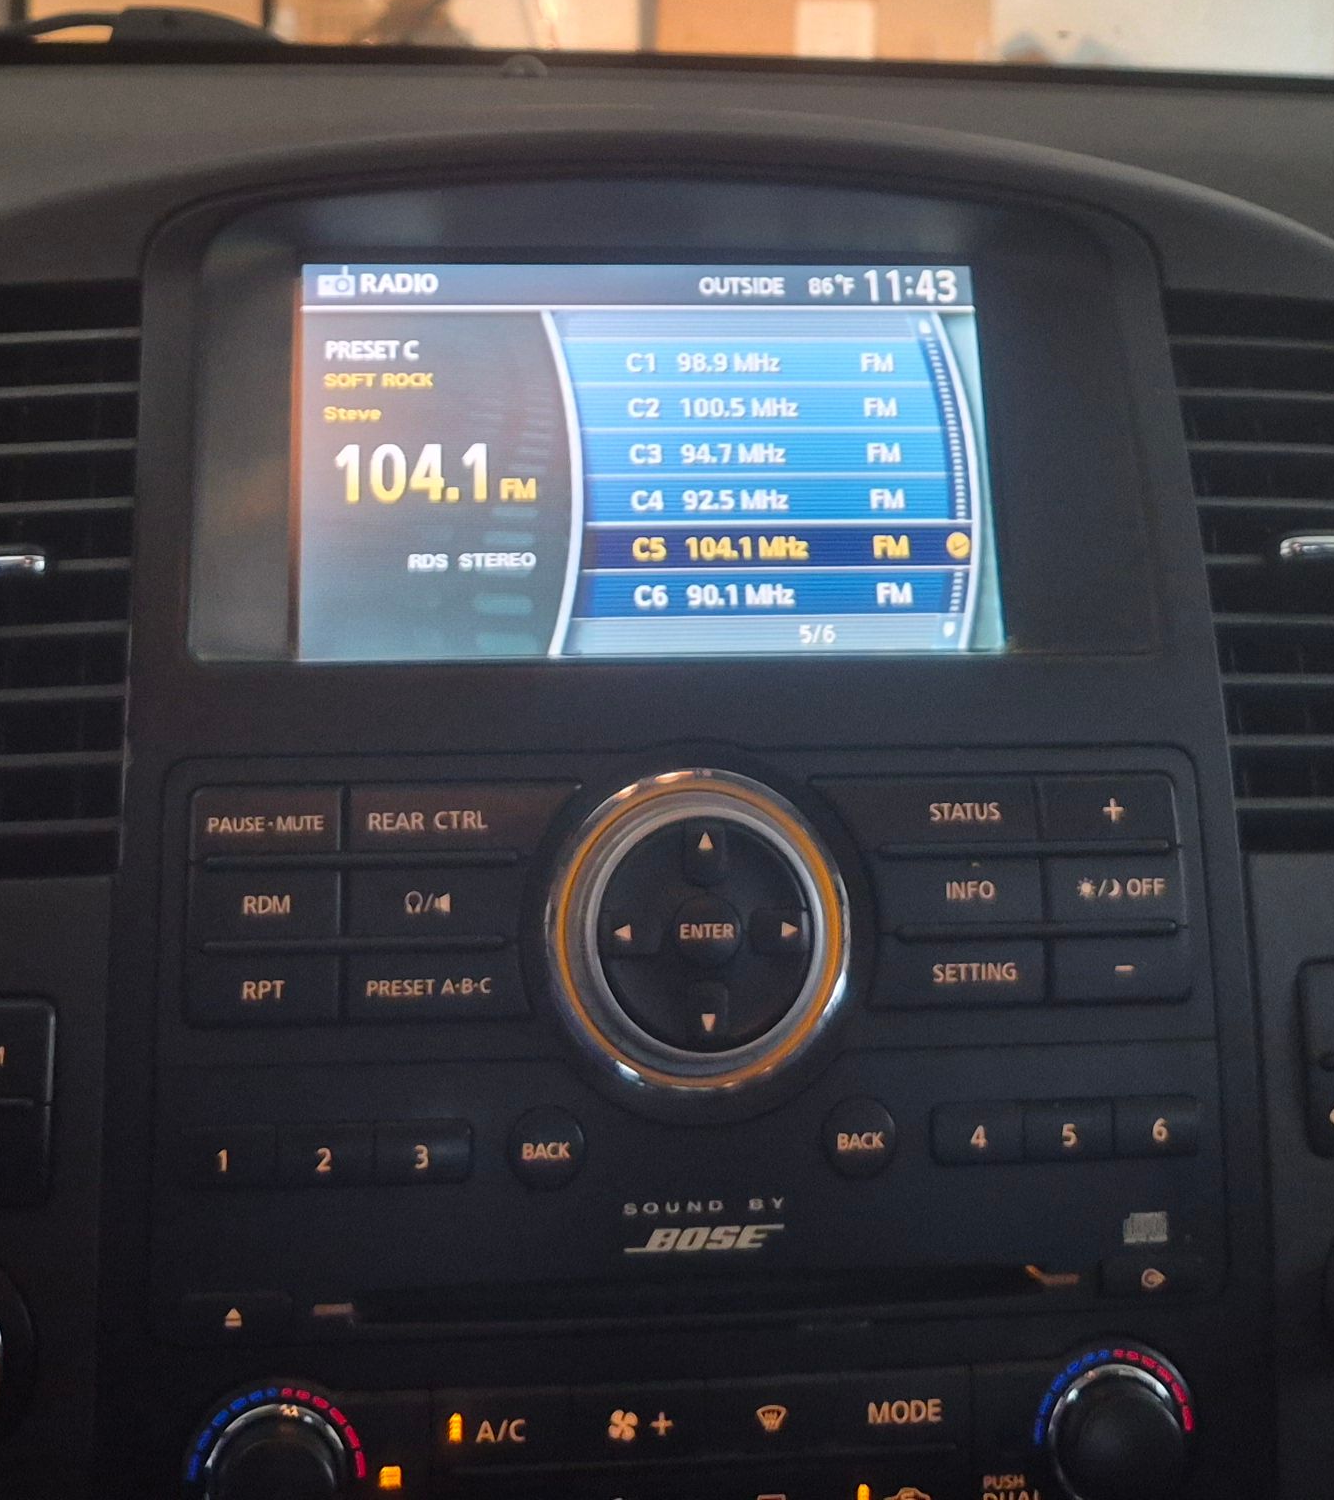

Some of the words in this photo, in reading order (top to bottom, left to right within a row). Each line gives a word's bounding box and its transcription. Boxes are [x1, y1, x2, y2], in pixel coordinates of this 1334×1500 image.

[359, 273, 439, 294] RADIO
[698, 276, 786, 296] OUTSIDE
[863, 268, 958, 303] 11:43
[324, 340, 400, 361] PRESET
[403, 340, 419, 361] C
[626, 351, 657, 374] C1
[677, 351, 729, 374] 98.9
[733, 351, 781, 374] MHz
[861, 351, 894, 373] FM
[323, 372, 377, 390] SOFT
[381, 372, 434, 389] ROCK
[323, 406, 382, 424] Steve
[627, 397, 660, 420] C2
[679, 397, 747, 420] 100.5
[751, 397, 799, 419] MHz
[864, 397, 897, 418] FM
[629, 443, 662, 466] C3
[680, 443, 734, 466] 94.7
[738, 443, 786, 465] MHz
[867, 443, 901, 464] FM
[335, 443, 488, 504] 104.1
[498, 478, 538, 502] FM
[630, 489, 664, 512] C4
[682, 489, 736, 512] 92.5
[740, 489, 789, 511] MHz
[870, 489, 905, 510] FM
[632, 537, 666, 561] C5
[685, 537, 752, 560] 104.1
[757, 537, 809, 560] MHz
[873, 535, 909, 558] FM
[407, 553, 449, 572] RDS
[458, 552, 537, 571] STEREO
[634, 585, 668, 609] C6
[686, 585, 739, 607] 90.1
[744, 585, 795, 607] MHz
[876, 583, 912, 604] FM
[799, 623, 836, 646] 5/6
[368, 812, 425, 832] REAR
[434, 810, 488, 831] CTRL
[929, 802, 1002, 822] STATUS
[946, 880, 996, 900] INFO
[1126, 877, 1166, 898] OFF
[243, 894, 292, 915] RDM
[679, 923, 735, 941] ENTER
[932, 962, 1017, 983] SETTING
[242, 980, 286, 1000] RPT
[367, 979, 436, 998] PRESET
[837, 1130, 886, 1151] BACK
[970, 1124, 988, 1149] 4
[1061, 1122, 1079, 1148] 5
[1152, 1117, 1169, 1143] 6
[216, 1148, 229, 1173] 1
[315, 1147, 332, 1173] 2
[414, 1144, 430, 1170] 3
[521, 1141, 571, 1161] BACK
[623, 1199, 724, 1216] SOUND
[748, 1196, 785, 1211] BY
[624, 1223, 785, 1253] BOSE
[868, 1399, 942, 1425] MODE
[474, 1418, 527, 1443] A/C
[982, 1474, 1025, 1490] PUSH
